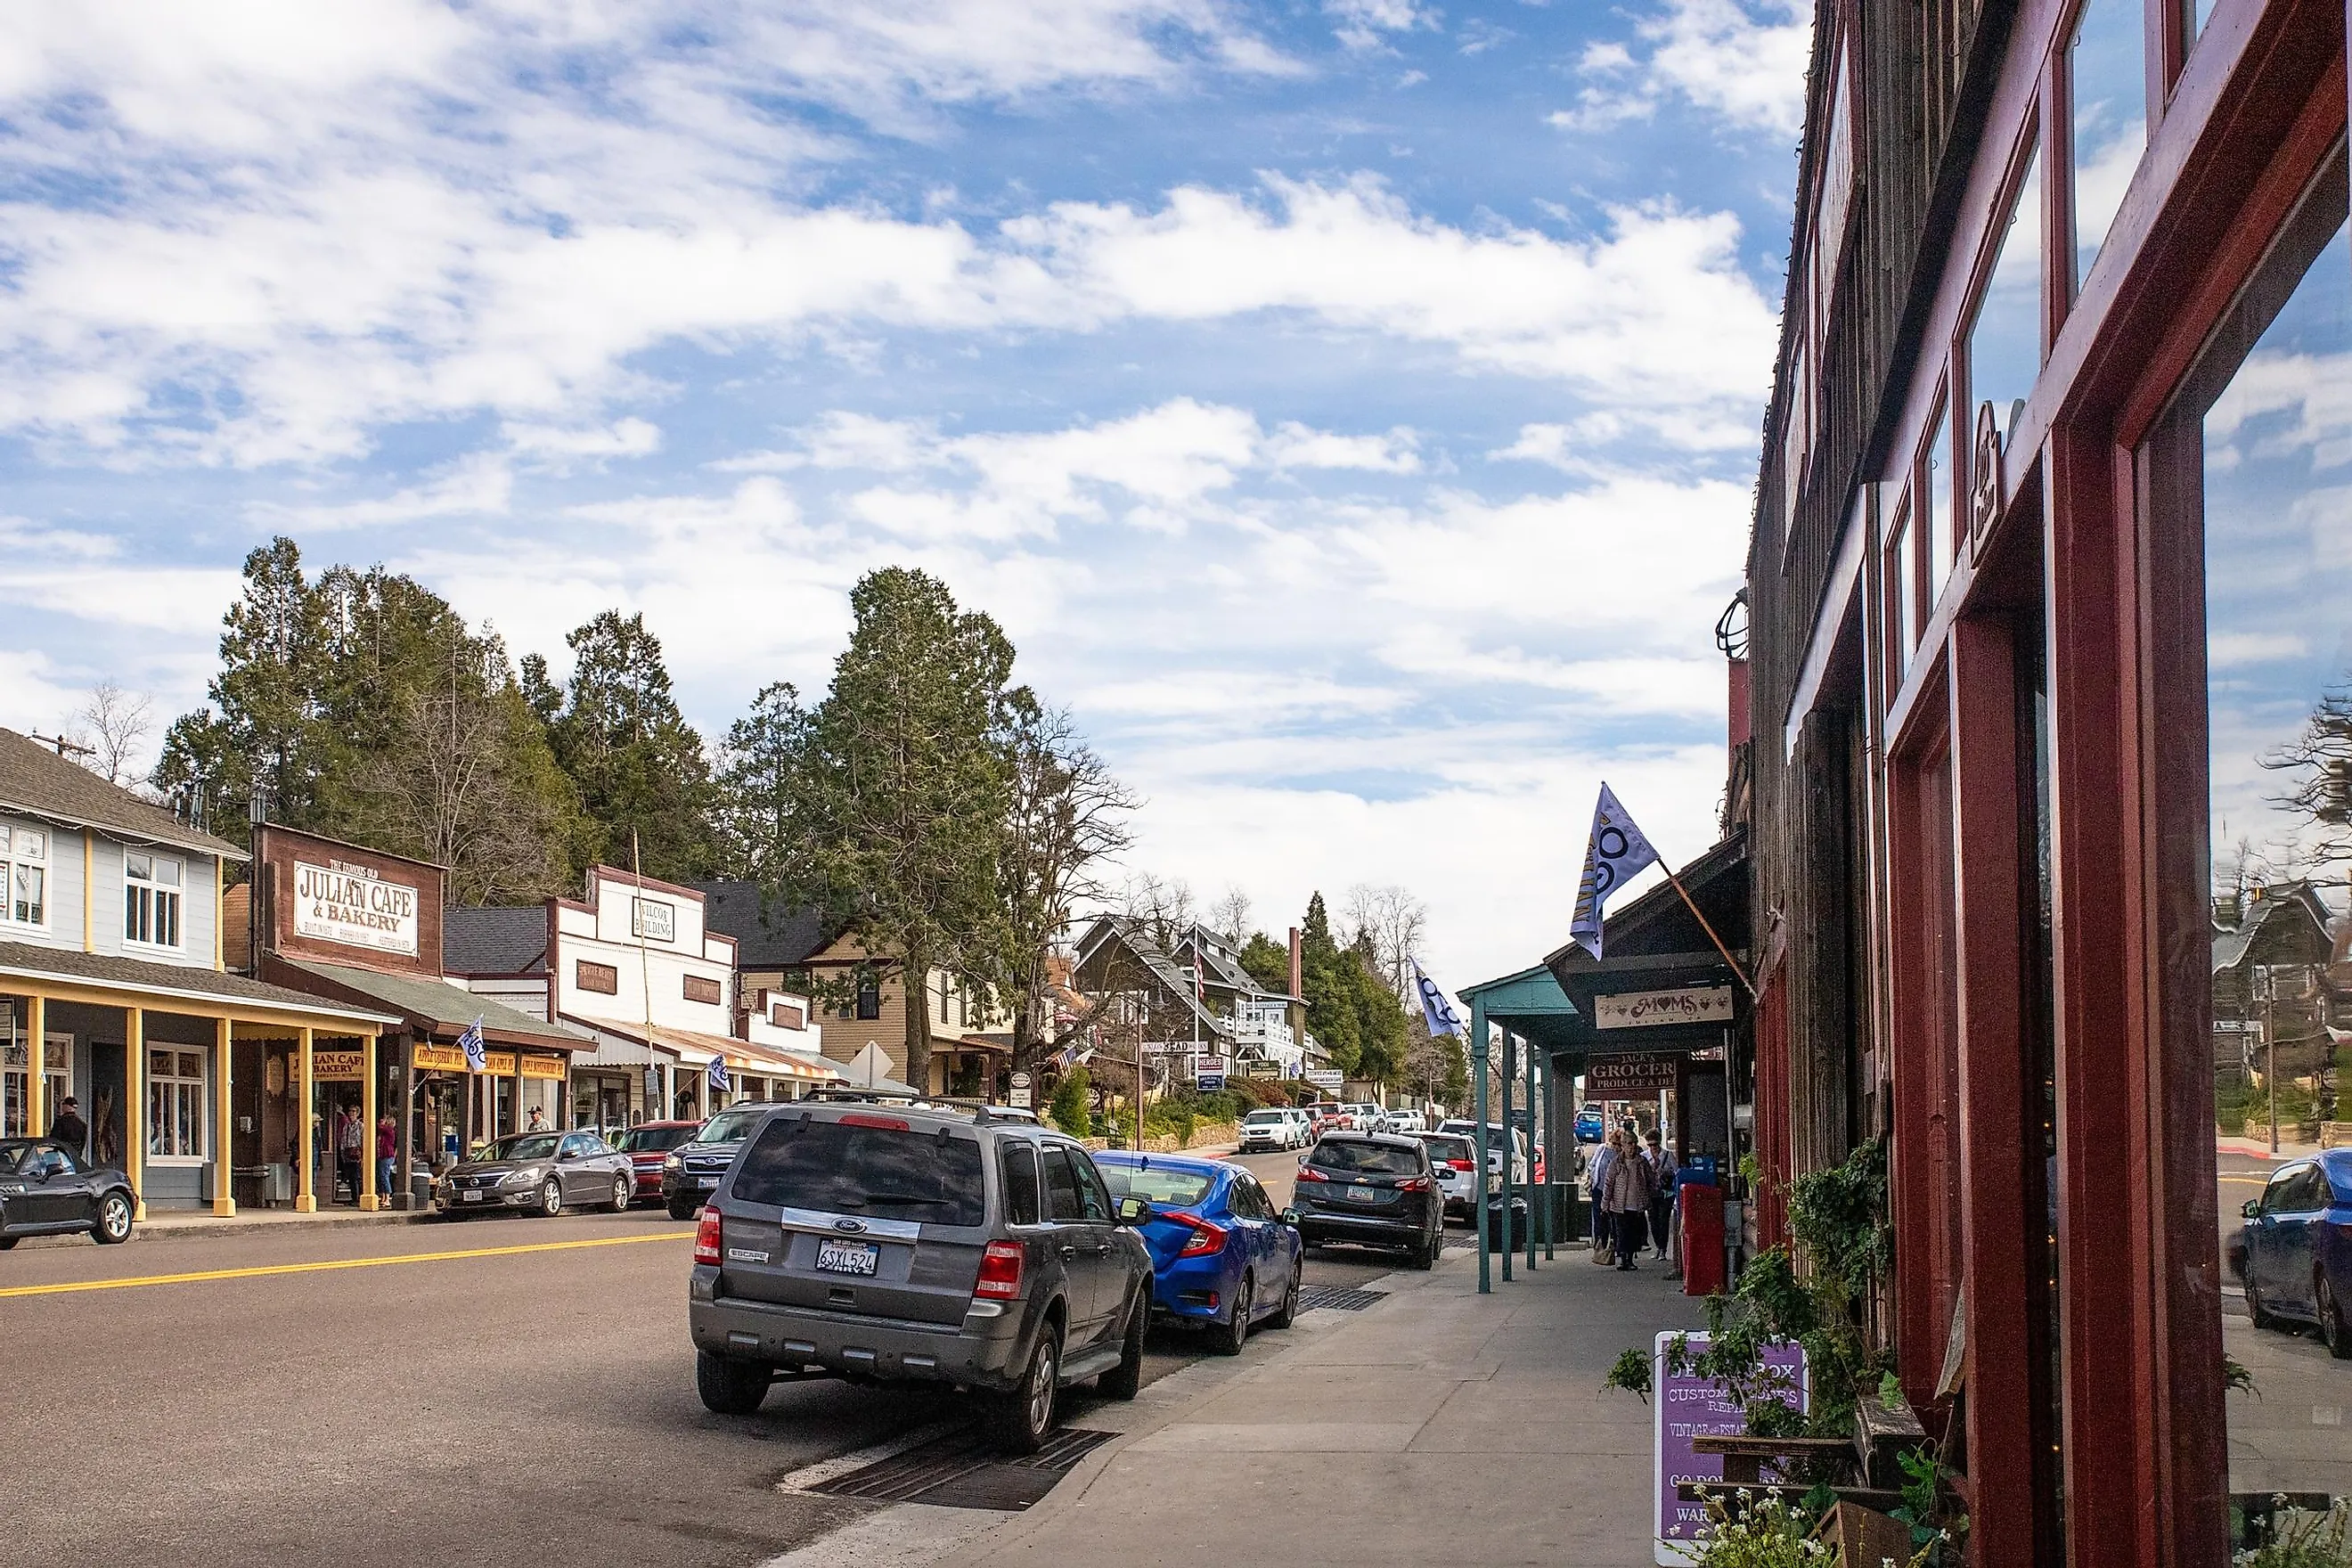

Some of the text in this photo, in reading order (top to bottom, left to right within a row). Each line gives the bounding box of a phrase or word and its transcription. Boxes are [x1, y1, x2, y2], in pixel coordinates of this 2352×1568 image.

[329, 858, 379, 879] THE FAMOUS OLD
[299, 870, 412, 918] JULIAN CAFE
[313, 901, 401, 933] & BAKERY
[293, 1055, 335, 1070] JIAN
[313, 1064, 354, 1074] BAKERY
[1198, 1058, 1222, 1067] HEROES
[1591, 1062, 1675, 1078] GROCER
[1597, 1077, 1646, 1089] PRODUCE
[731, 1250, 767, 1259] ESCAPE
[820, 1249, 873, 1270] 6SXL524
[1669, 1388, 1727, 1402] CUSTOM
[1670, 1424, 1709, 1437] VINTAGE
[1719, 1425, 1748, 1436] ESTAT
[1676, 1507, 1711, 1522] WAR
